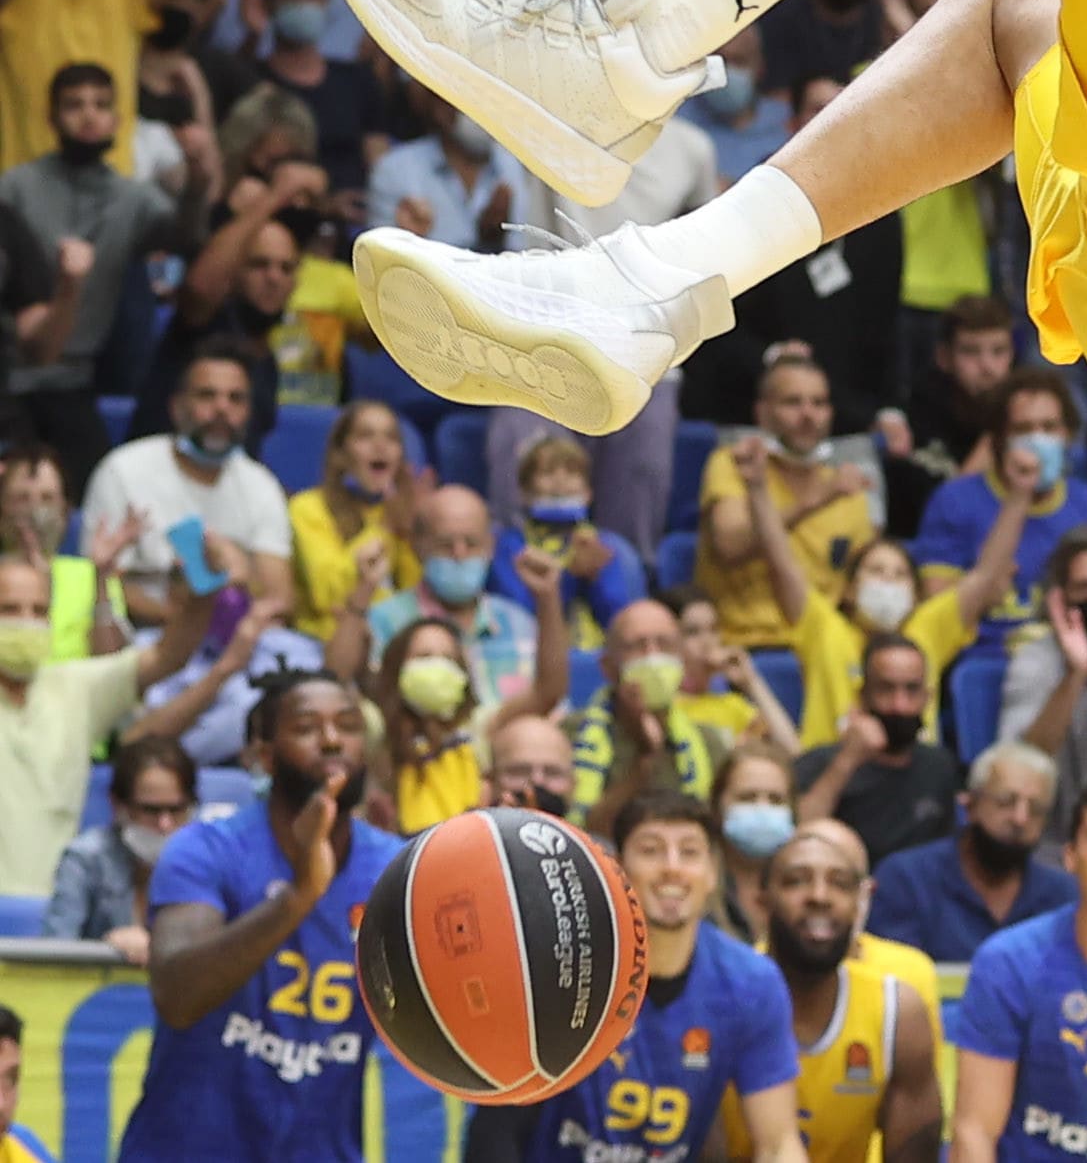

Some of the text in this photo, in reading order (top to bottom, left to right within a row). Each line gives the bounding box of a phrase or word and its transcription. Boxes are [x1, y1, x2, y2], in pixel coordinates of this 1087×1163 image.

[561, 858, 592, 1030] TURKISH AIRLINES
[269, 951, 355, 1024] 26
[603, 1078, 690, 1144] 99
